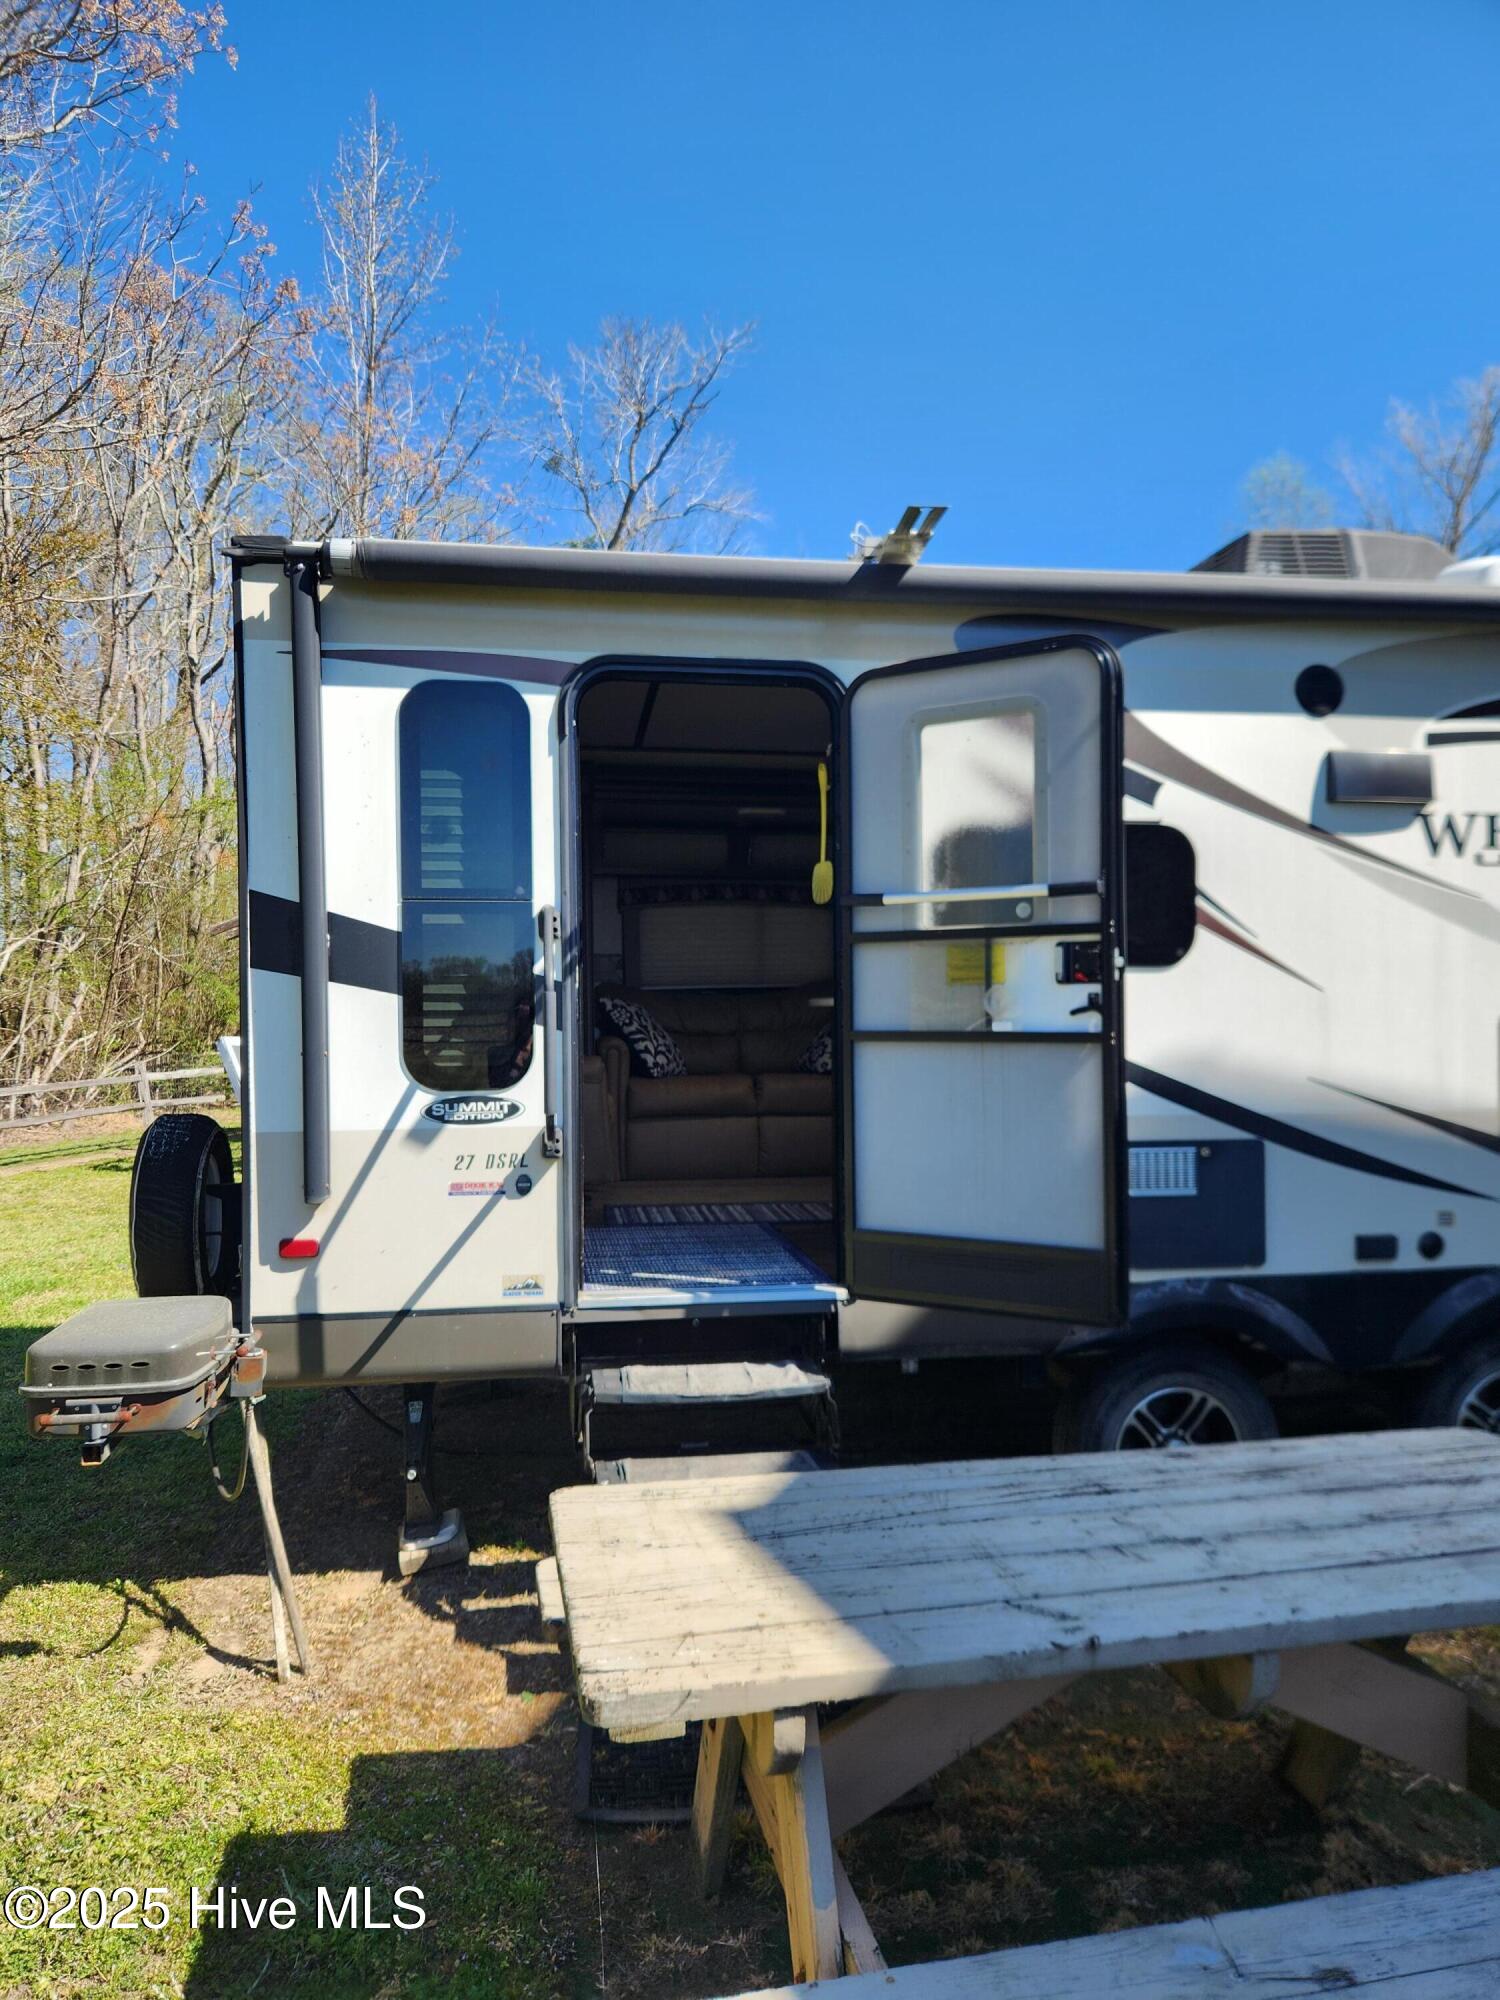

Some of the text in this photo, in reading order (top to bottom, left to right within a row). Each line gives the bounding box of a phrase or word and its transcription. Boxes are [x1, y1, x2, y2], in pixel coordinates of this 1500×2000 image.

[431, 1101, 513, 1116] SUMMIT
[444, 1111, 505, 1121] EDITION
[454, 1152, 529, 1171] 27 DSRL
